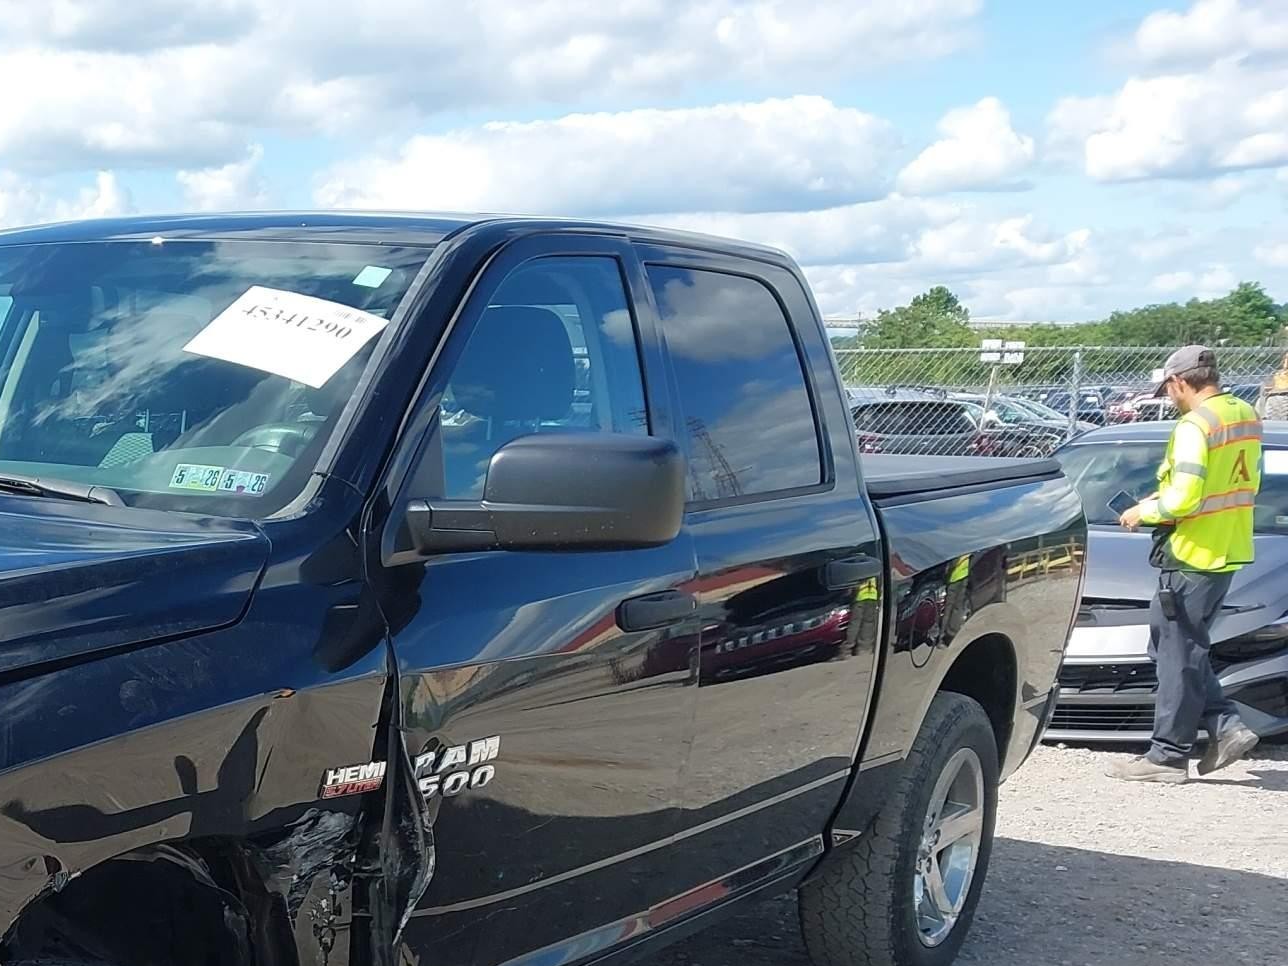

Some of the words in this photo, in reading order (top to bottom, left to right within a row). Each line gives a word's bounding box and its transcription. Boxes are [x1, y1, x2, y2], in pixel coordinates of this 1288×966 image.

[242, 304, 353, 340] 45341290
[205, 470, 220, 486] 26
[252, 475, 267, 492] 26
[415, 735, 501, 775] RAM
[327, 761, 387, 786] HEMI
[418, 765, 495, 797] 500
